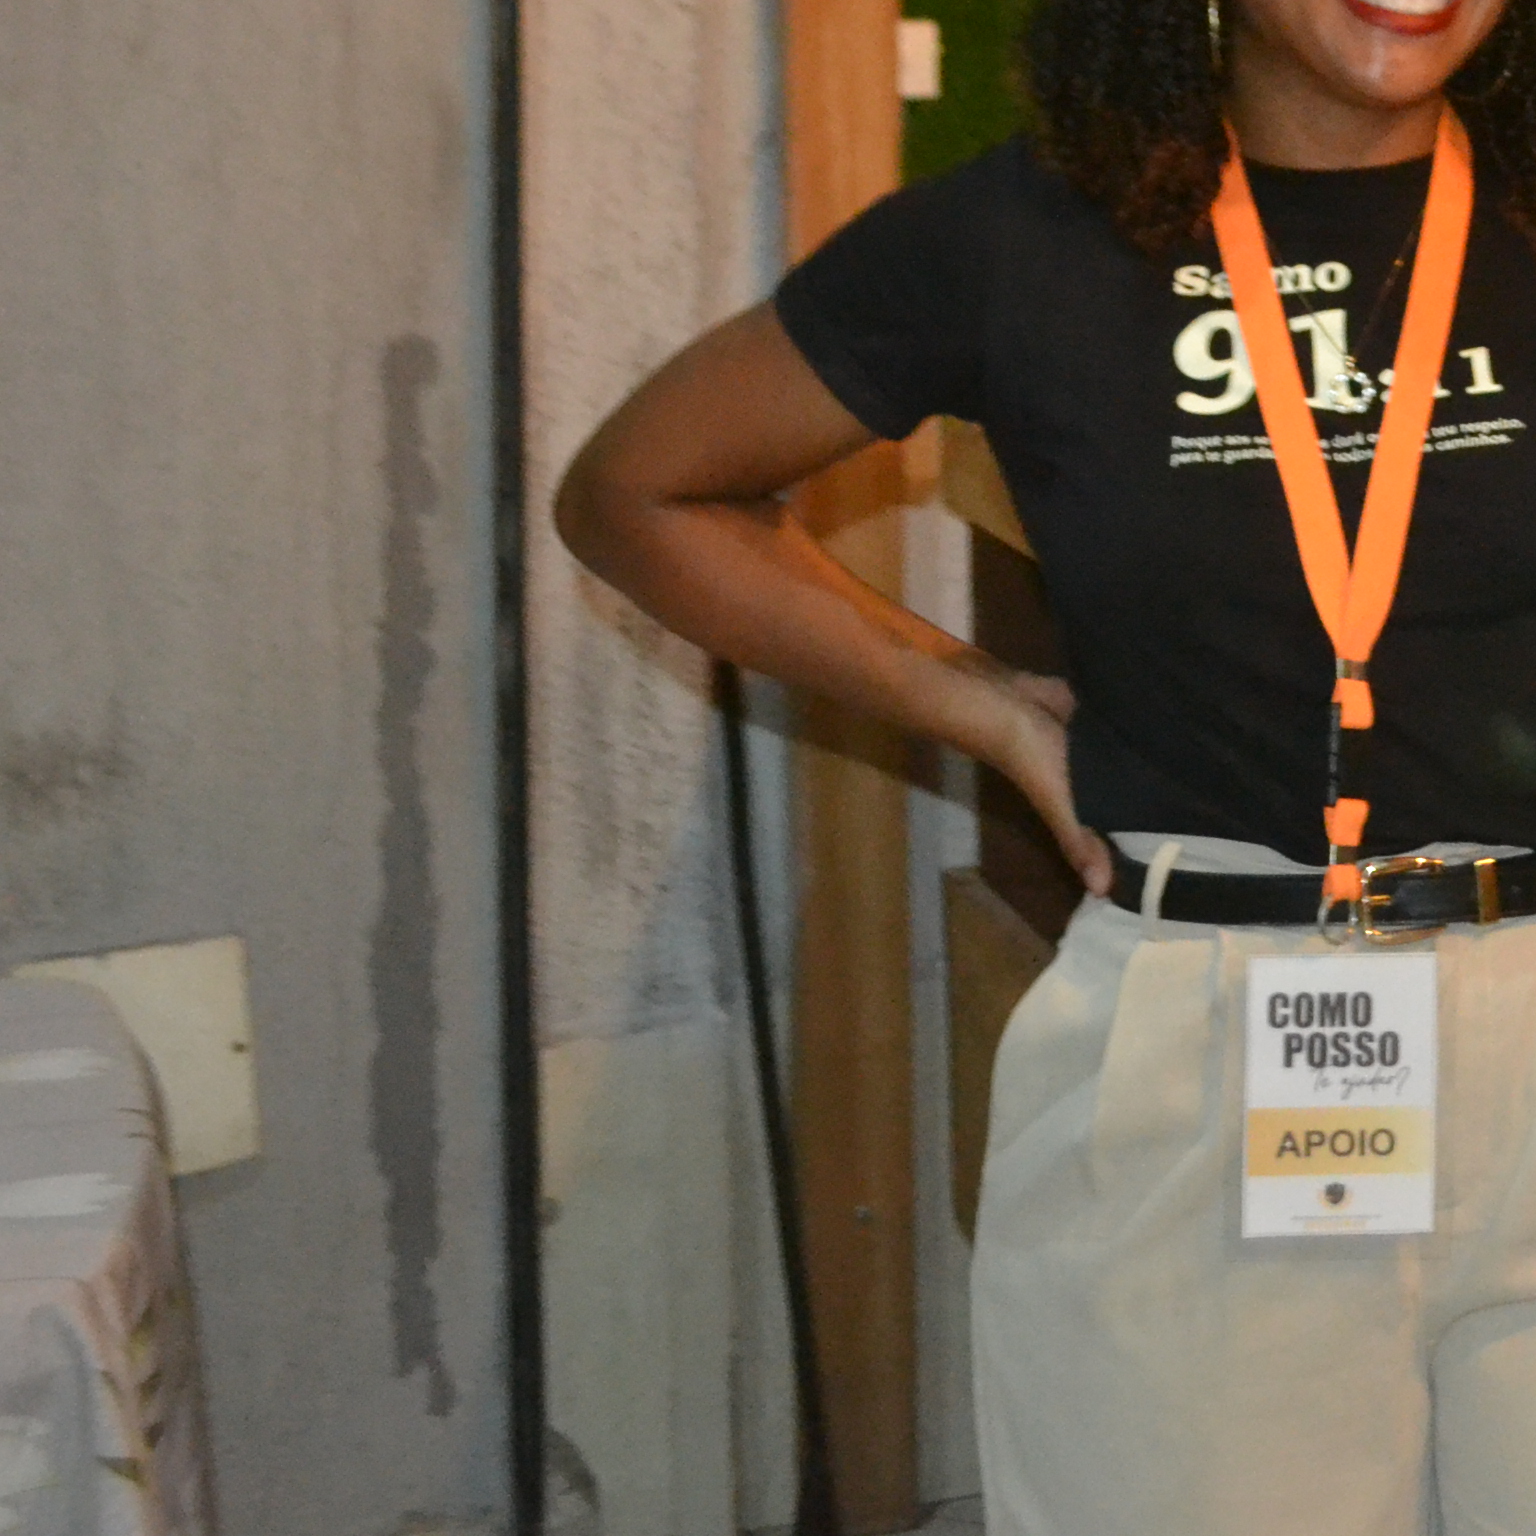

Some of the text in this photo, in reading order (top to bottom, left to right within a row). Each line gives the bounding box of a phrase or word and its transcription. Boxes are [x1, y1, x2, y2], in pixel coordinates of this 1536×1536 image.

[1172, 261, 1352, 298] samo
[1267, 991, 1374, 1029] COMO
[1283, 1031, 1401, 1069] POSSO
[1276, 1127, 1396, 1159] APOIO
